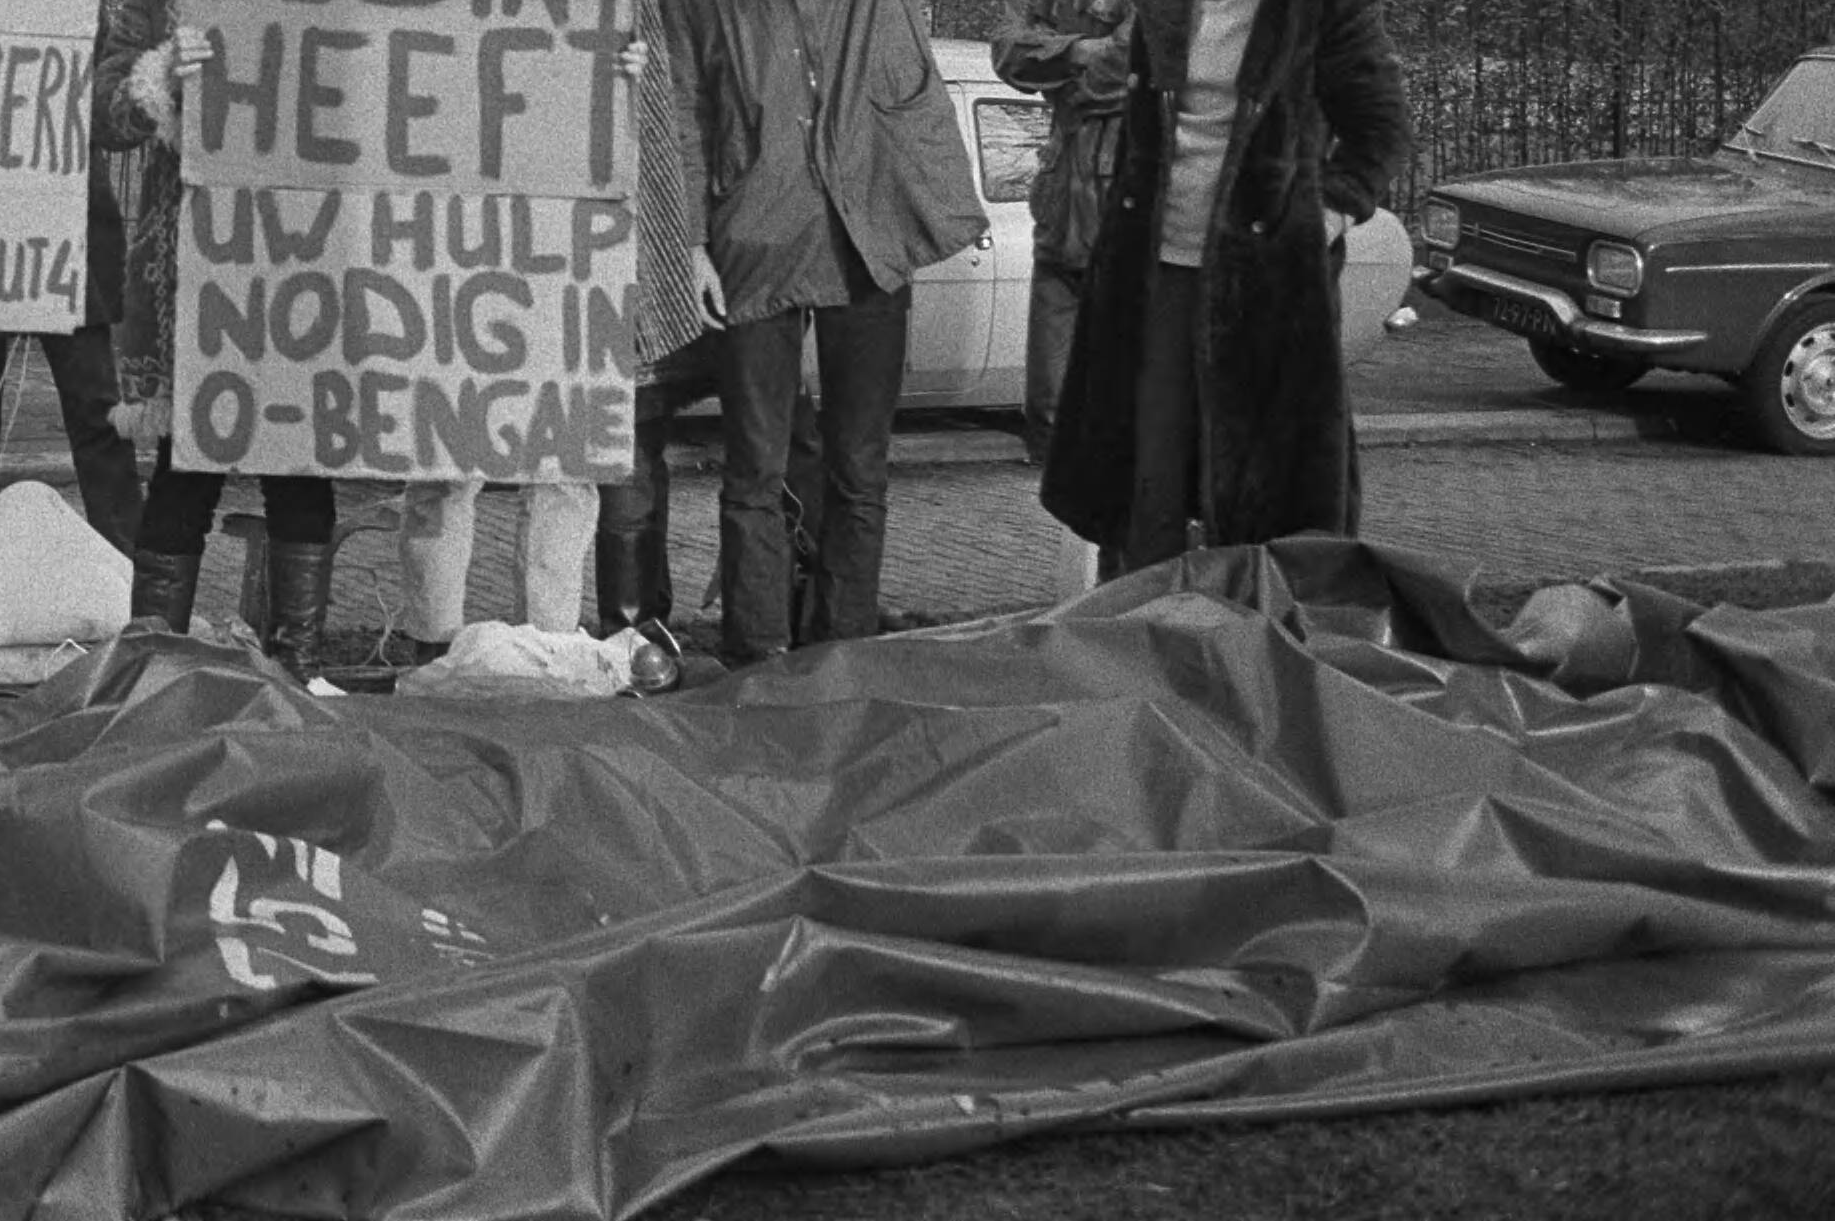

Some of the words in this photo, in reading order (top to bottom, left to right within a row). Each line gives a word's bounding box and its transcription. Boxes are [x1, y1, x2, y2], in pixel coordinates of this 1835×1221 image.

[201, 22, 634, 184] HEEFT
[189, 187, 342, 266] UW
[371, 189, 634, 282] HULP
[197, 268, 535, 374] NODIG
[563, 282, 639, 379] IN
